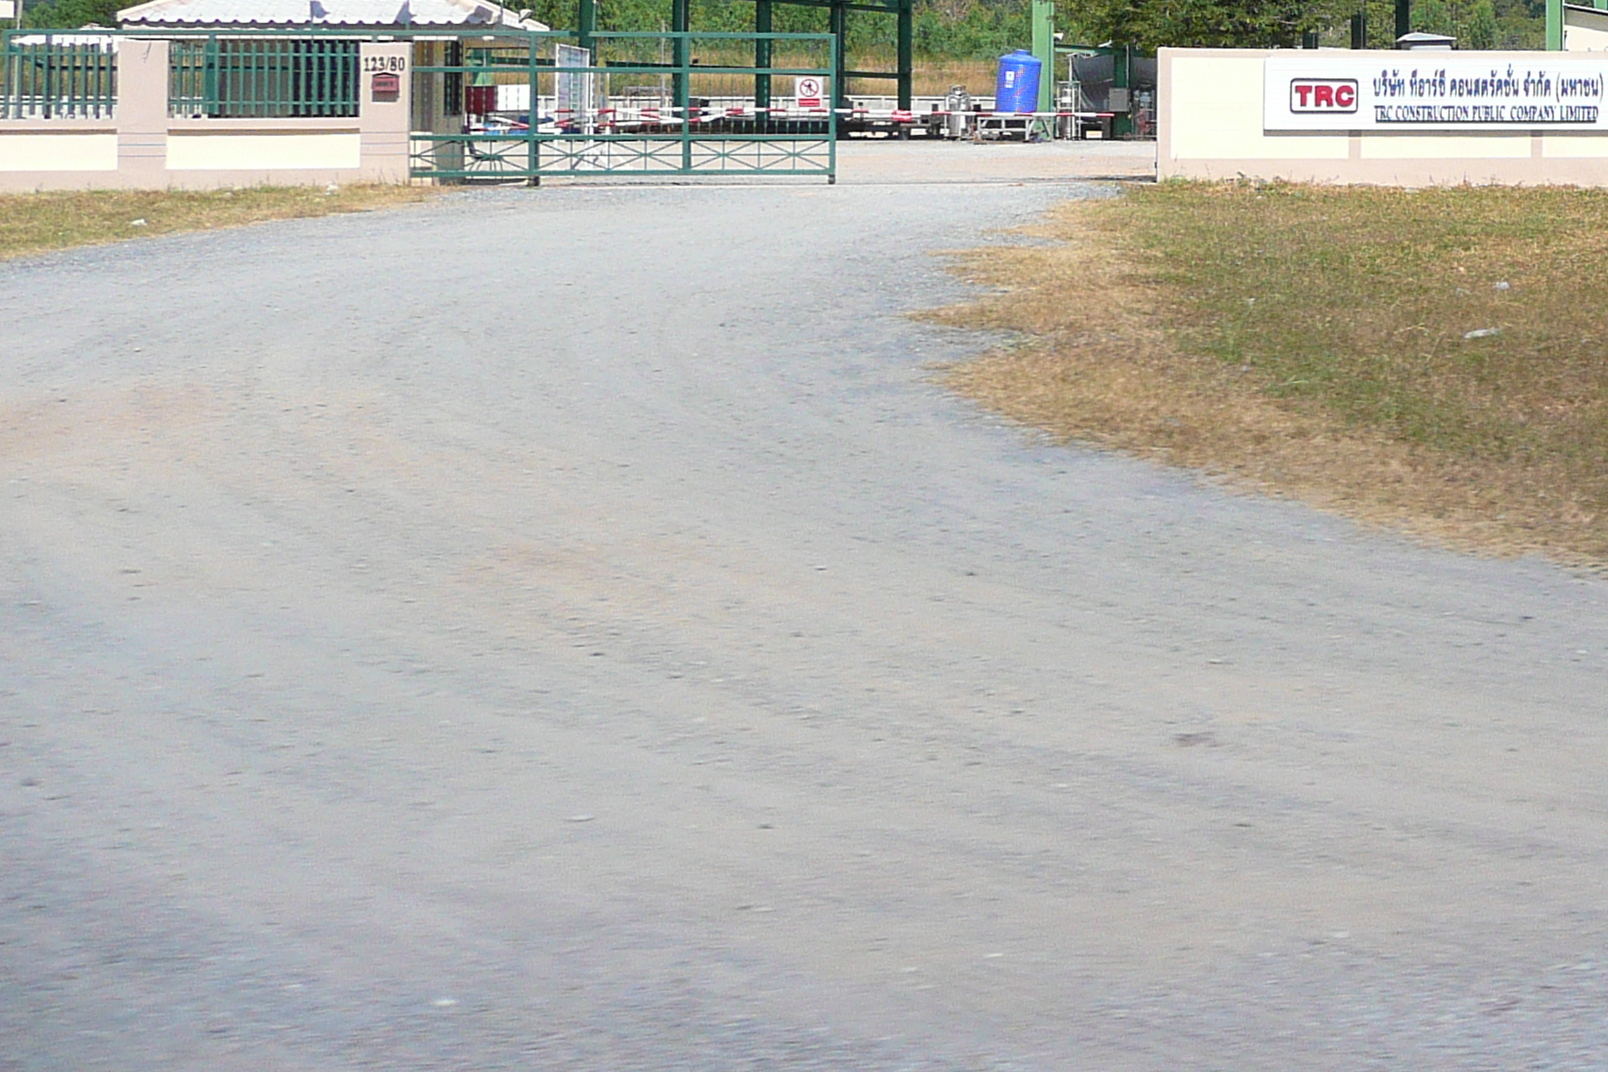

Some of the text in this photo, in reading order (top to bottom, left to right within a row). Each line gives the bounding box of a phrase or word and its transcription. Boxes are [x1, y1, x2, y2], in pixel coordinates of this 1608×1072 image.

[364, 56, 405, 72] 123/80
[1373, 69, 1405, 97] บริษัท
[1409, 68, 1446, 97] ทีอาร์ซี
[1523, 70, 1551, 97] จำกัด
[1295, 85, 1355, 108] TRC
[1374, 105, 1599, 121] TRC CONSTRUCTION PUBLIC COMPANY LIMITED
